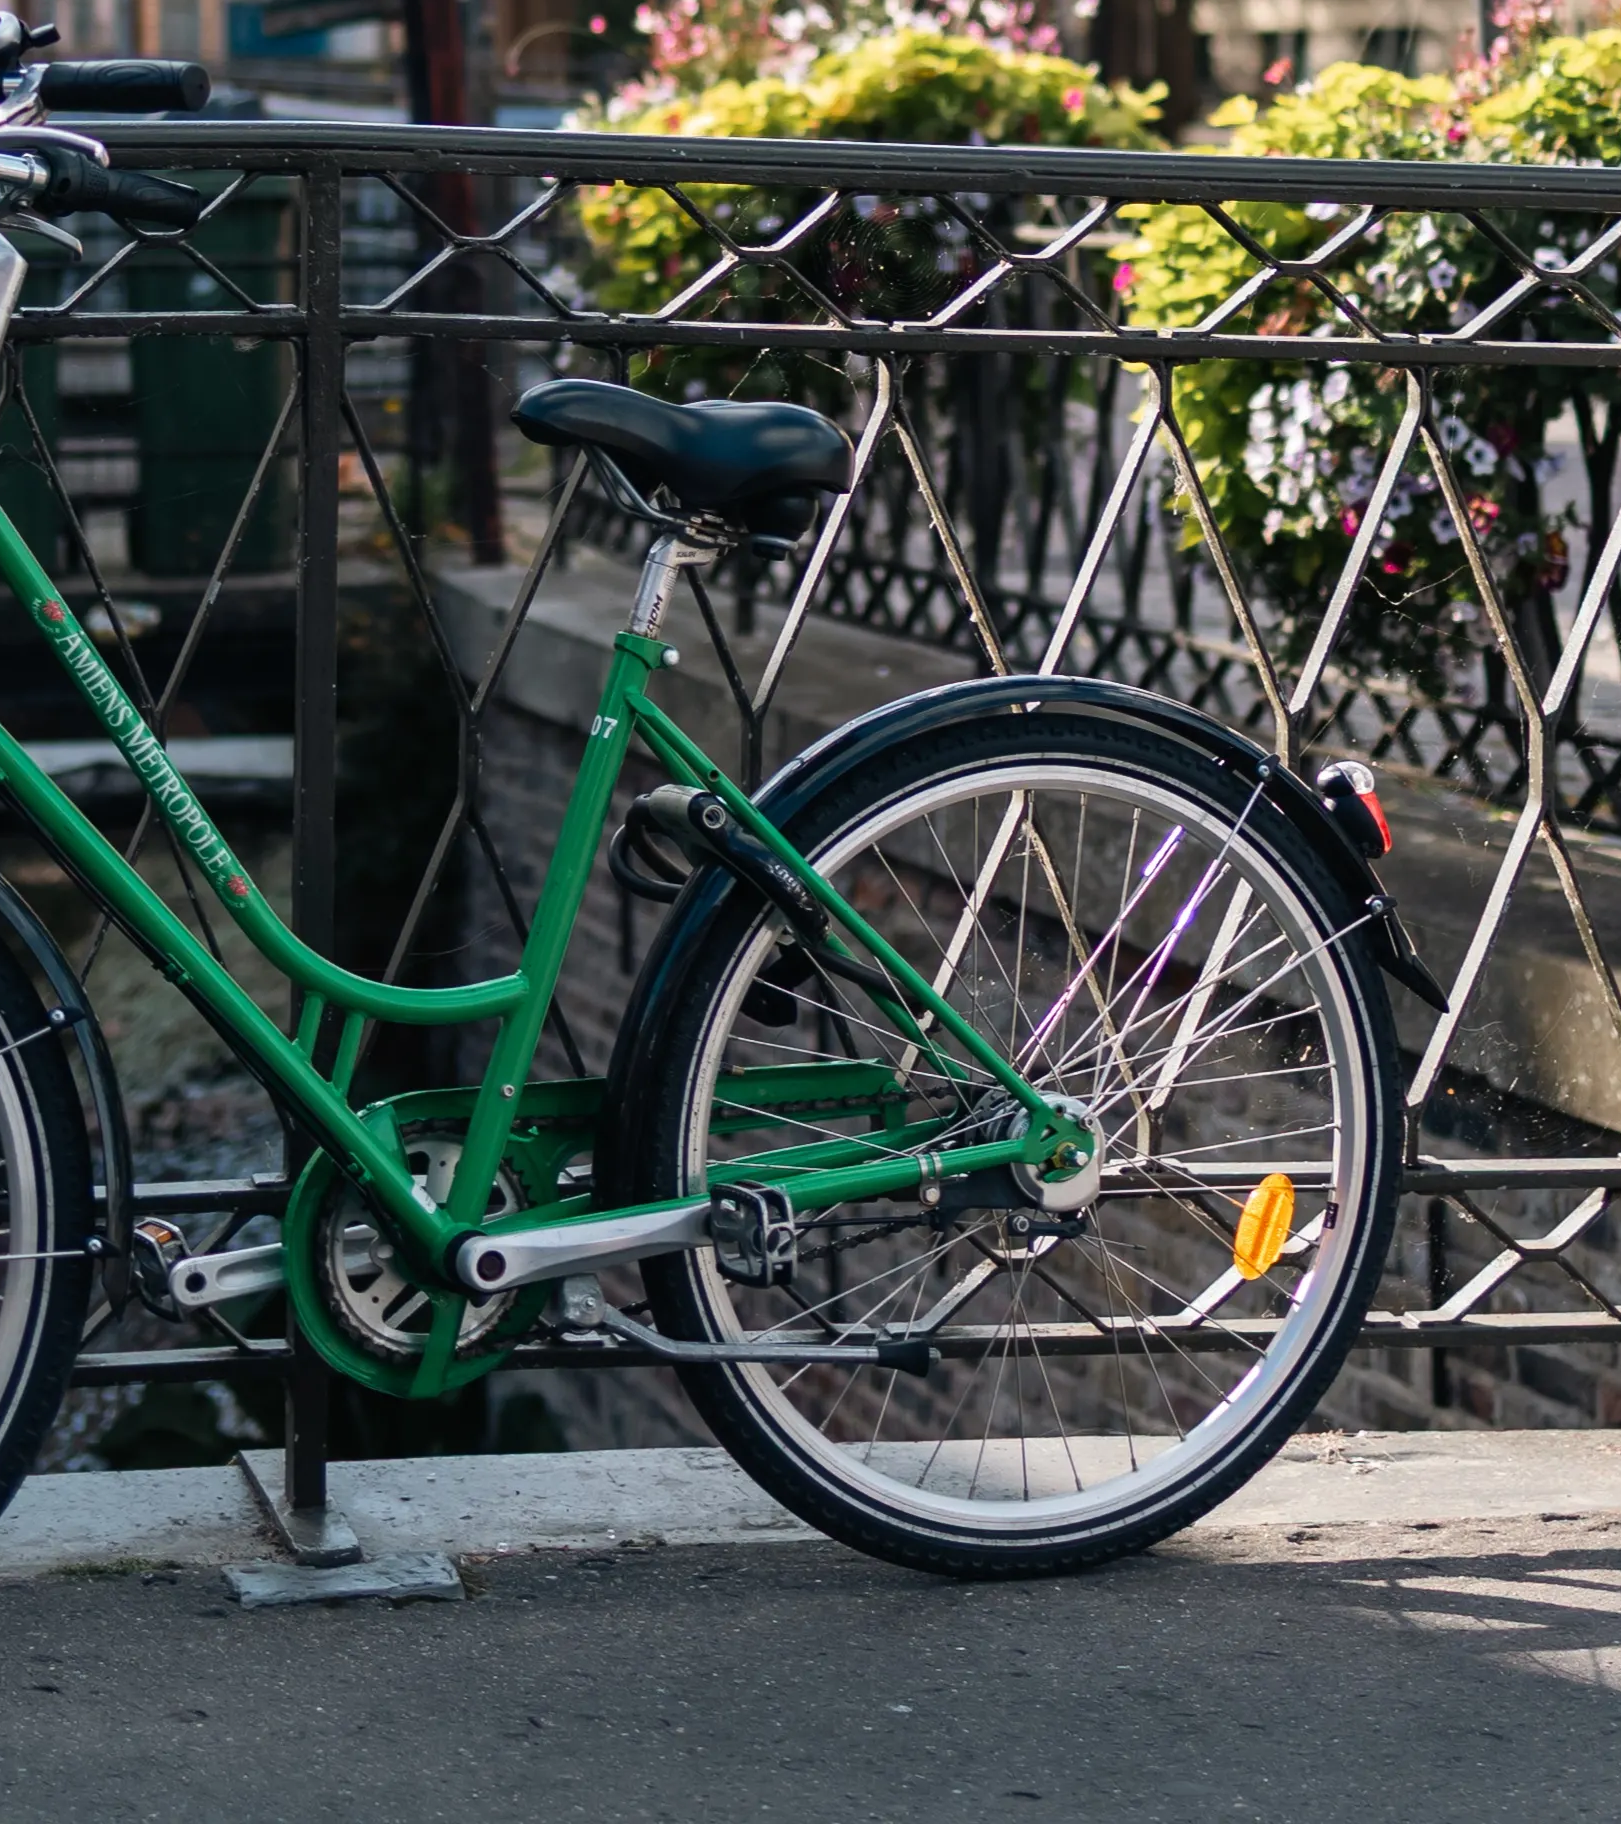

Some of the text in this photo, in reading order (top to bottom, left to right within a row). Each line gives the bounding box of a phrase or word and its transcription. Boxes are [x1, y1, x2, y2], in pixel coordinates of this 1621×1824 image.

[646, 594, 663, 638] OOM
[590, 714, 619, 739] 07
[54, 632, 231, 874] AMIENS MÉTROPOLE
